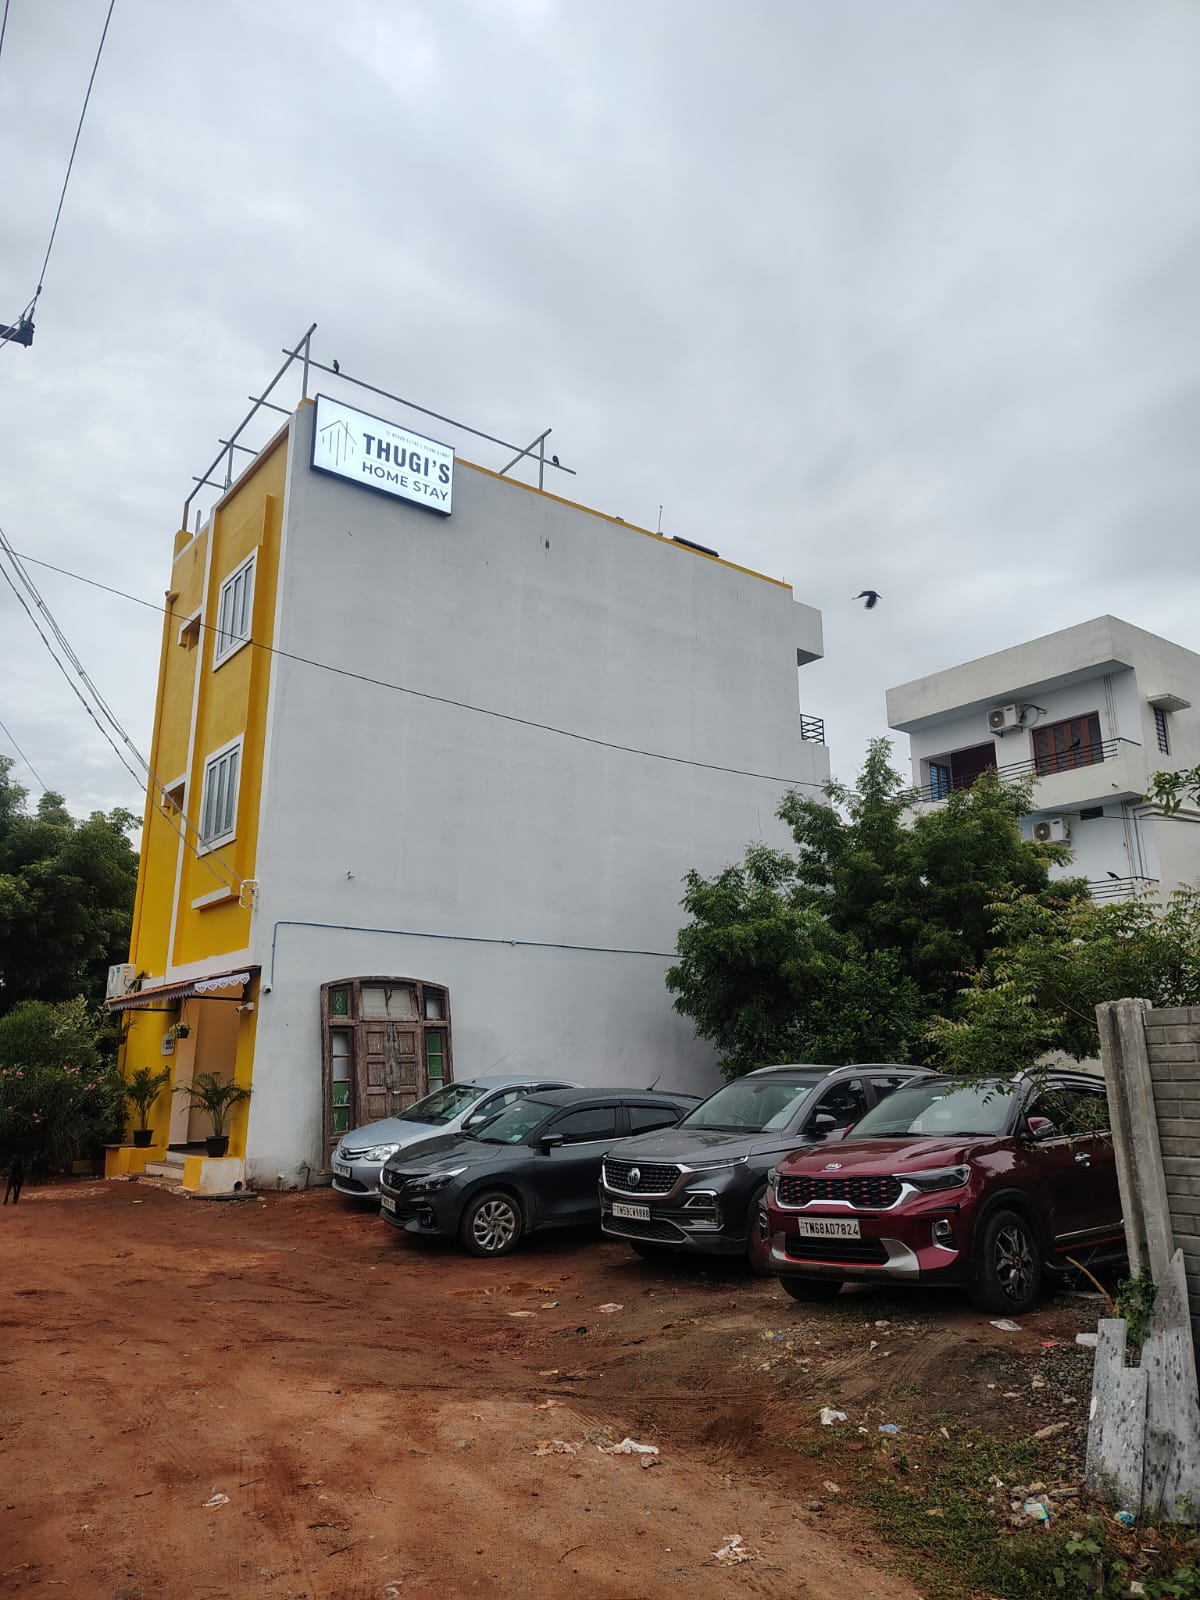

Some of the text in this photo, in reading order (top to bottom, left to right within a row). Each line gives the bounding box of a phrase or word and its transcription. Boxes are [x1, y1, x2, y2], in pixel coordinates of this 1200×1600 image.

[362, 433, 450, 484] THUGI'S
[362, 461, 449, 501] HOME STAY
[804, 1222, 859, 1236] TN68AD7824
